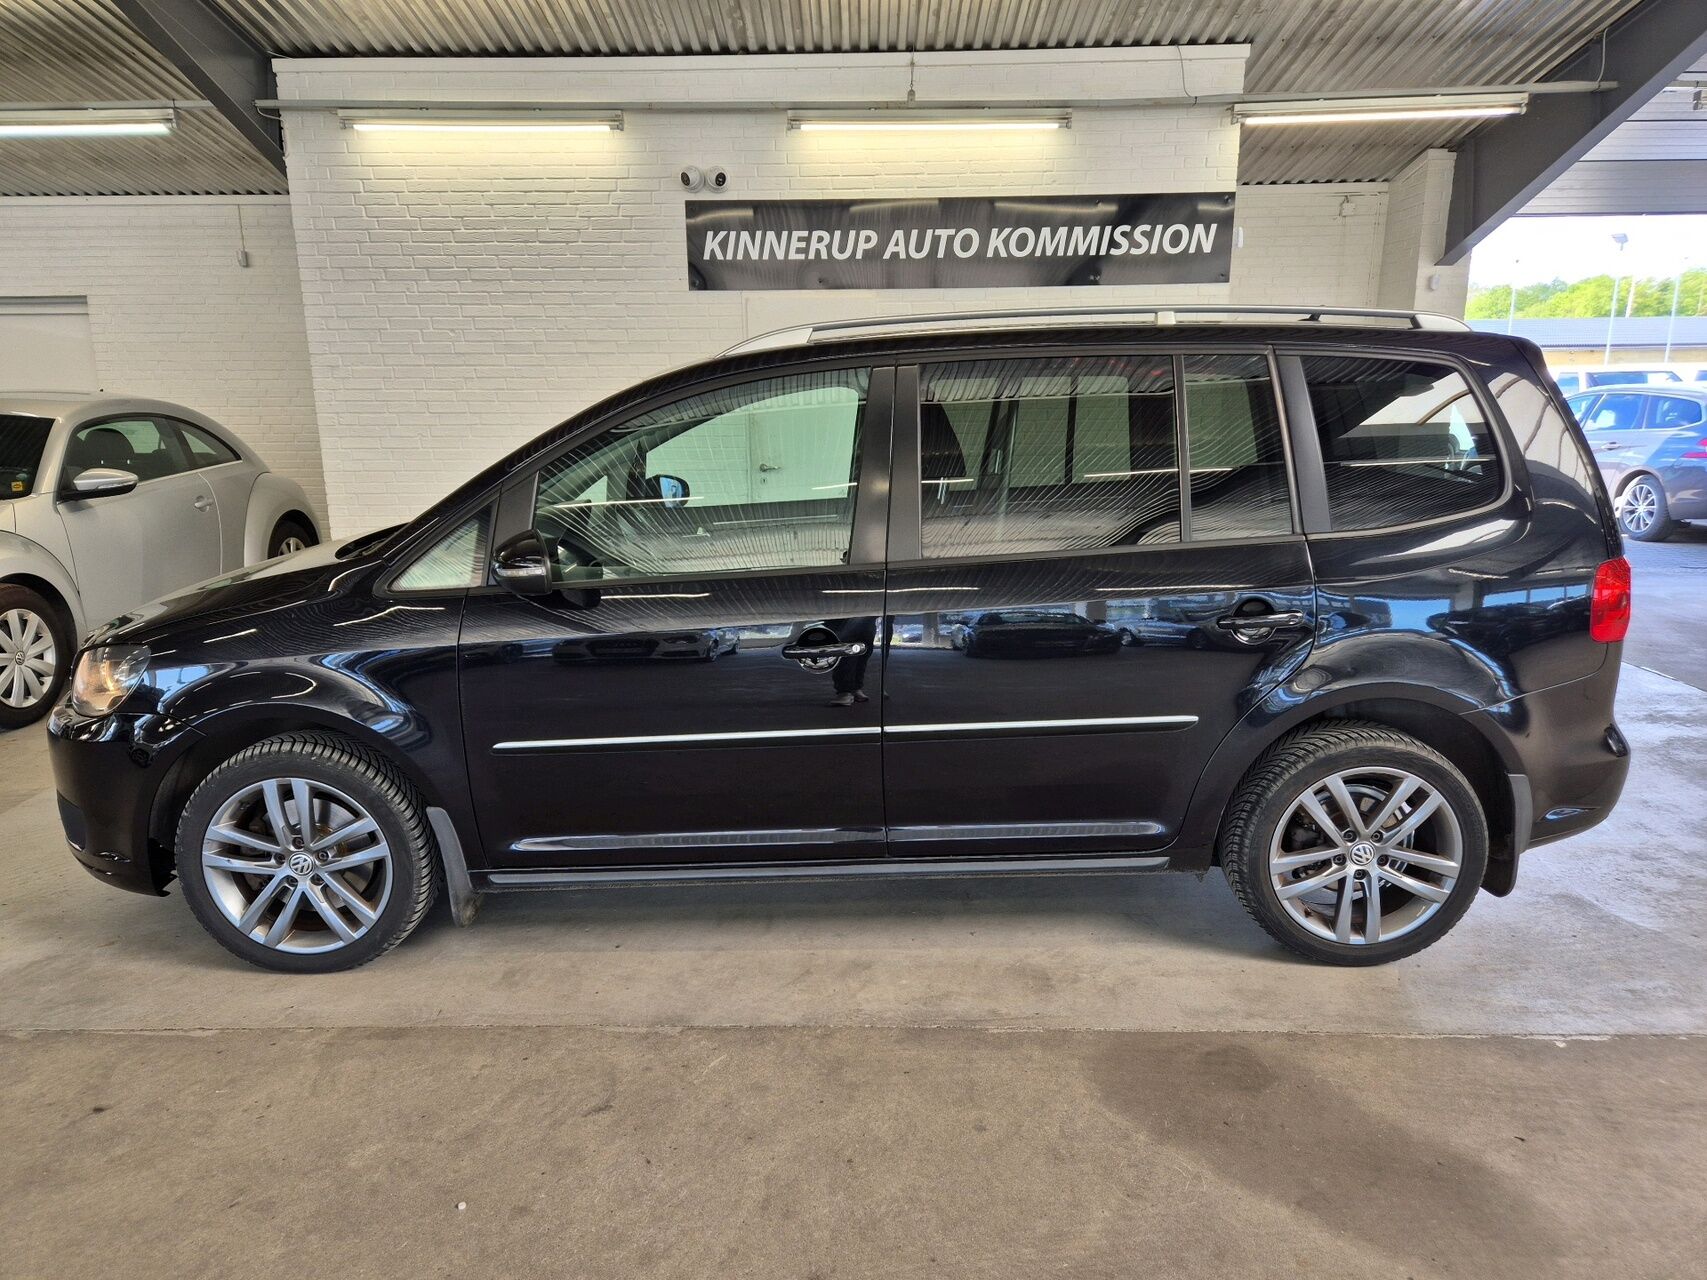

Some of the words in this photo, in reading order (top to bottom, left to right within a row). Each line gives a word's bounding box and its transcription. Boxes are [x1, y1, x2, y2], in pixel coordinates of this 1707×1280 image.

[703, 230, 879, 261] KINNERUP
[882, 228, 980, 260] AUTO
[986, 223, 1218, 258] KOMMISSION
